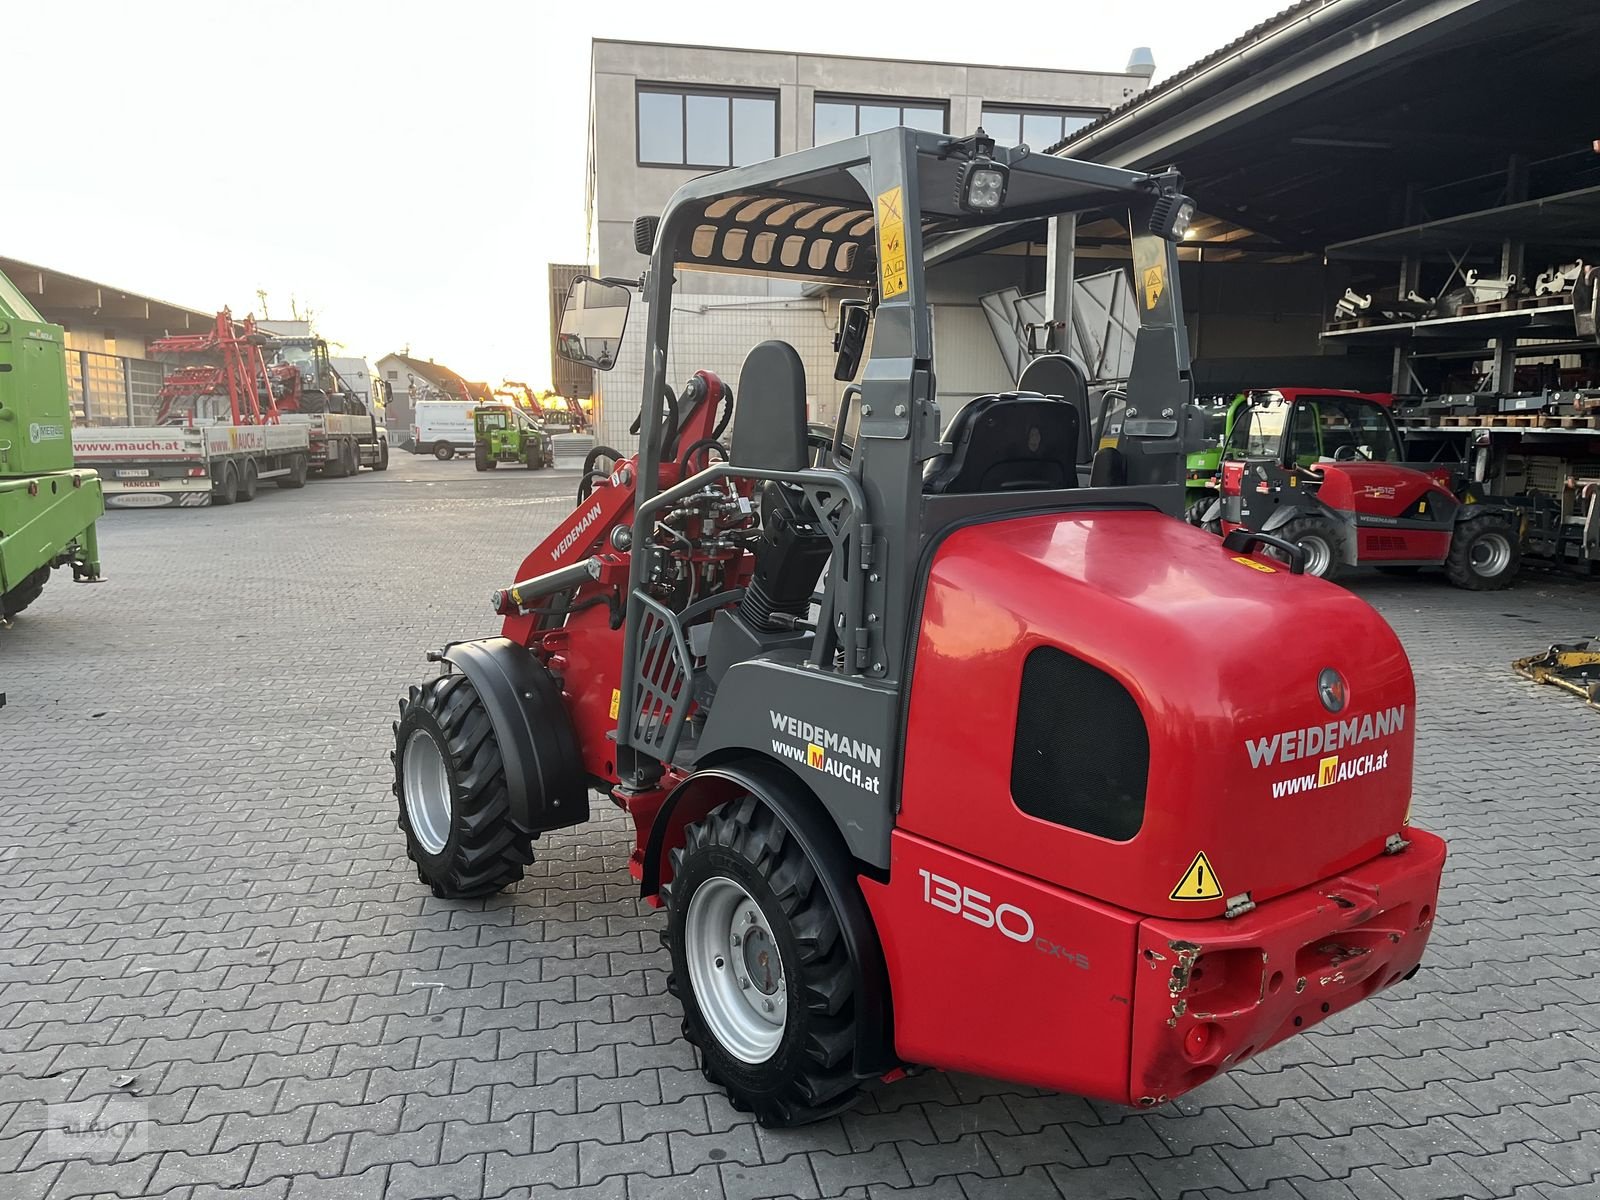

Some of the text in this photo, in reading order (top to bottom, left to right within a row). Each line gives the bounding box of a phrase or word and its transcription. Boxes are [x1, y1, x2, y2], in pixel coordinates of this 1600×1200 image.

[74, 440, 179, 452] www.mauch.at
[551, 502, 602, 561] WEIDEMANN
[769, 709, 881, 768] WEIDEMANN
[1245, 704, 1405, 769] WEIDEMANN
[772, 739, 880, 795] www.MAUCH.at
[1272, 749, 1389, 799] www.MAUCH.at
[919, 868, 1035, 943] 1350
[1035, 937, 1090, 970] CX45
